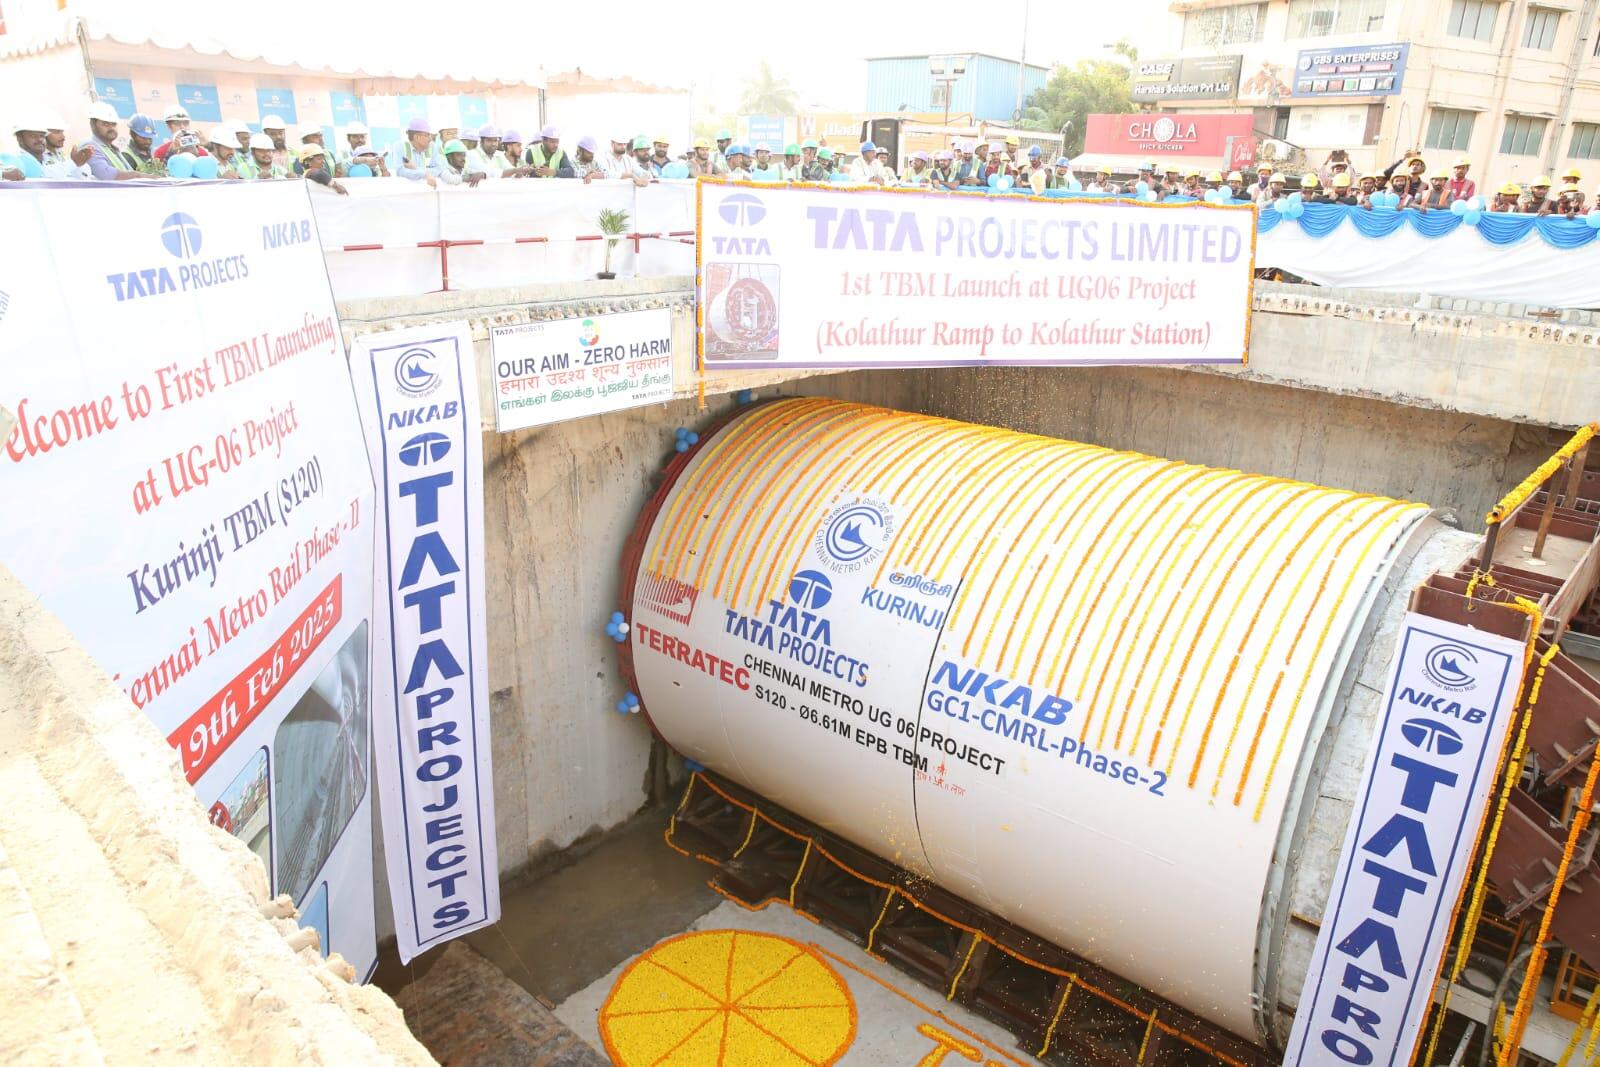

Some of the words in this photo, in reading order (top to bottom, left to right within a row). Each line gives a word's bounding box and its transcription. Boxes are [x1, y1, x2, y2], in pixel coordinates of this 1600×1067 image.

[1140, 63, 1173, 75] CASE
[1313, 55, 1332, 65] GBS
[1333, 51, 1400, 64] ENTERPRISES
[1167, 83, 1199, 93] Solution
[1200, 83, 1214, 93] Pvt
[1216, 82, 1230, 92] Ltd
[1128, 117, 1197, 142] CHOLA
[1158, 143, 1184, 151] KITCHEN
[262, 219, 312, 250] NKAB
[711, 236, 772, 256] TATA
[806, 206, 924, 253] TATA
[934, 215, 1099, 261] PROJECTS
[1111, 221, 1242, 264] LIMITED
[106, 267, 177, 301] TATA
[178, 254, 249, 292] PROJECTS
[839, 270, 873, 297] 1st
[879, 271, 937, 299] TBM
[942, 270, 1020, 300] Launch
[1029, 275, 1053, 299] at
[1057, 274, 1121, 302] UG06
[1127, 276, 1197, 310] Project
[495, 328, 514, 336] TATA
[515, 325, 545, 335] PROJECTS
[815, 319, 927, 354] (Kolathur
[933, 320, 995, 356] Ramp
[1002, 322, 1024, 347] to
[1030, 318, 1124, 347] Kolathur
[1130, 319, 1211, 351] Station)
[497, 357, 537, 379] OUR
[540, 352, 570, 374] AIM
[583, 344, 626, 366] ZERO
[630, 338, 671, 359] HARM
[499, 375, 540, 396] हमारा
[592, 364, 620, 383] शून्य
[626, 355, 670, 379] नुकसान
[6, 395, 119, 463] elcome
[121, 382, 151, 421] to
[155, 355, 216, 410] First
[215, 335, 265, 387] TBM
[262, 312, 337, 371] Launching
[500, 392, 547, 411] எங்கள்
[550, 385, 595, 403] இலக்கு
[641, 372, 671, 389] தீங்கு
[632, 393, 647, 401] TATA
[388, 401, 458, 431] NKAB
[133, 468, 163, 515] at
[162, 428, 243, 497] UG-06
[243, 400, 299, 458] Project
[128, 523, 224, 616] Kurinji
[223, 494, 278, 553] TBM
[276, 455, 323, 527] (S120)
[816, 529, 831, 567] CHENNAI
[830, 561, 861, 574] METRO
[863, 548, 884, 566] RAIL
[113, 628, 202, 710] ennai
[203, 595, 268, 657] Metro
[268, 541, 303, 606] Rail
[303, 526, 340, 573] Phase
[350, 498, 360, 530] II
[398, 471, 465, 694] TATA
[767, 599, 831, 646] TATA
[861, 586, 945, 631] KURINJI
[246, 650, 286, 711] Feb
[289, 588, 336, 669] 2025
[636, 622, 750, 691] TERRATEC
[724, 609, 774, 651] TATA
[778, 633, 869, 688] PROJECTS
[743, 653, 806, 693] CHENNAI
[809, 680, 864, 717] METRO
[868, 704, 892, 729] UG
[896, 717, 916, 739] 06
[919, 727, 1006, 776] PROJECT
[930, 659, 1075, 728] NKAB
[1398, 687, 1486, 724] NKAB
[754, 684, 787, 711] S120
[855, 728, 888, 756] EPB
[891, 742, 929, 773] TBM
[927, 689, 1169, 798] GC1-CMRL-Phase-2
[417, 687, 470, 928] PROJECTS
[1335, 753, 1458, 980] TATA
